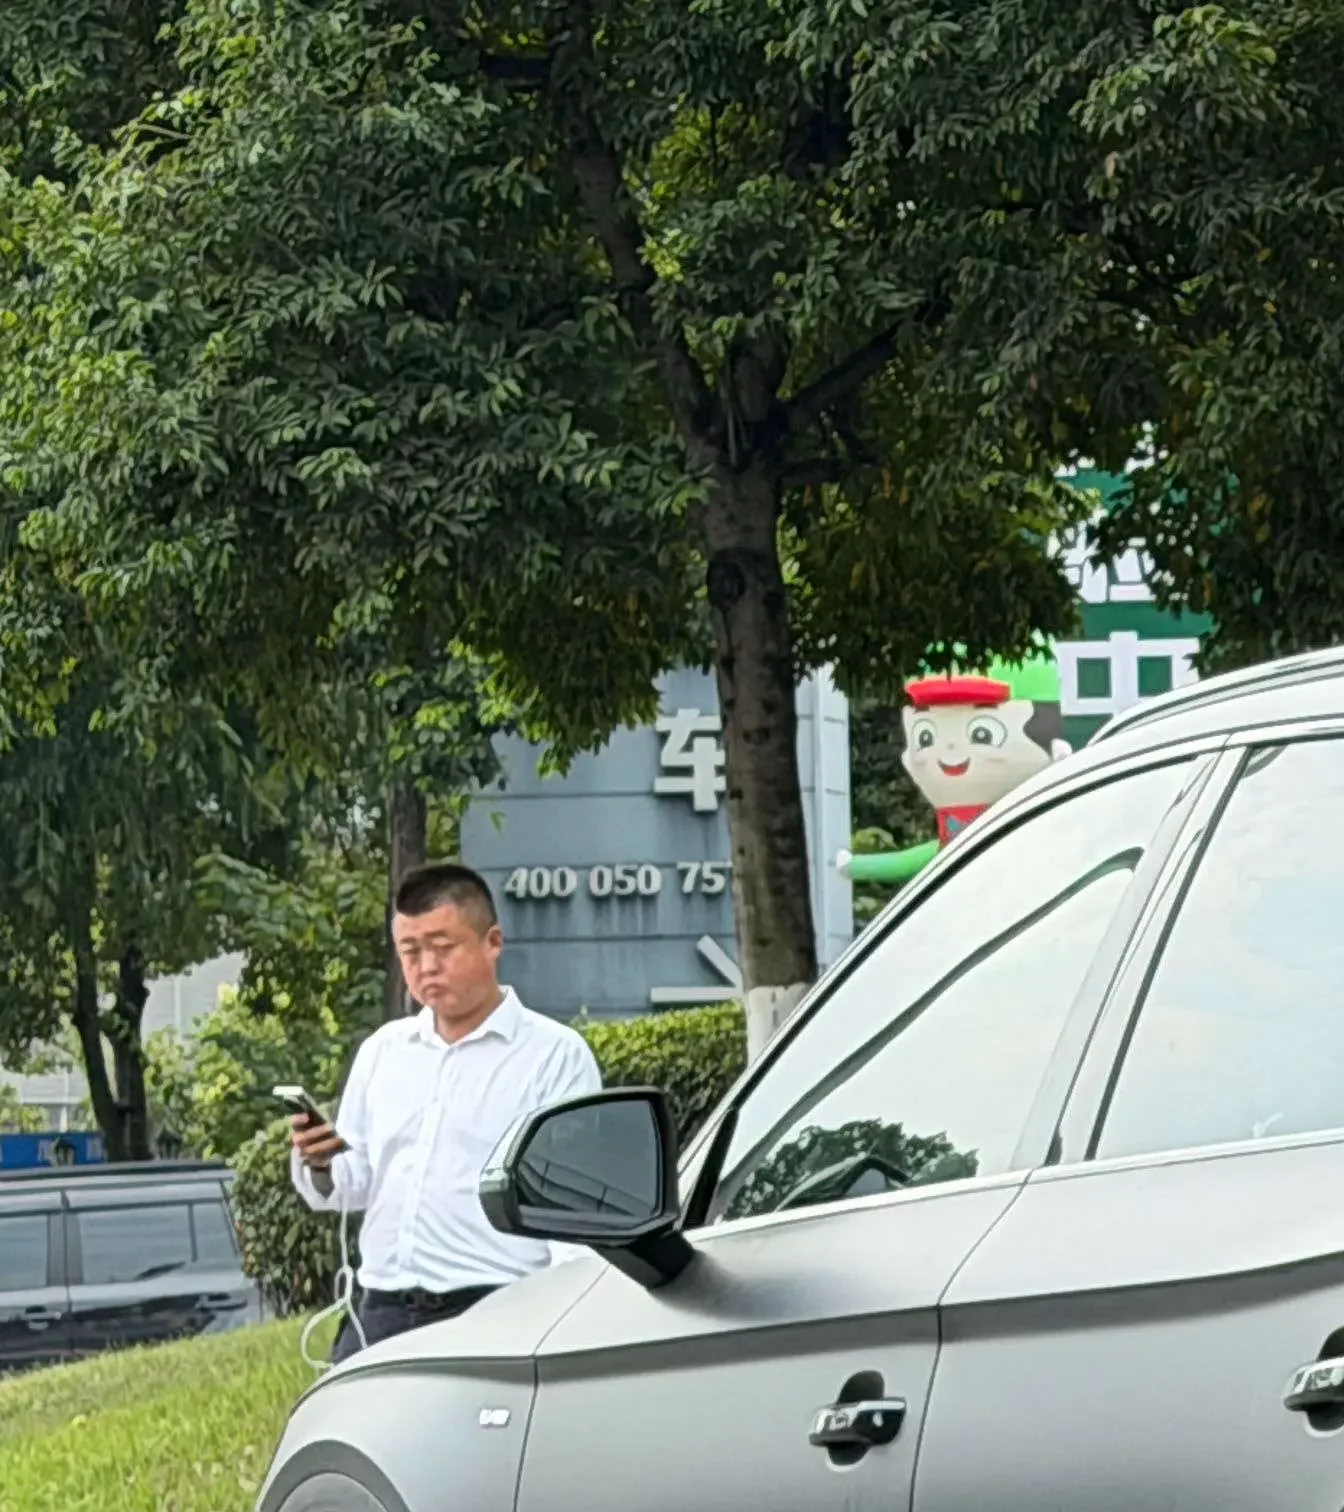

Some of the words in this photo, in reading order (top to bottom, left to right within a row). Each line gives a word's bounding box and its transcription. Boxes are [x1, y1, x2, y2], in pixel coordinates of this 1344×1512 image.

[656, 708, 727, 812] 车
[505, 867, 577, 898] 400
[590, 864, 662, 896] 050
[677, 861, 733, 894] 75
